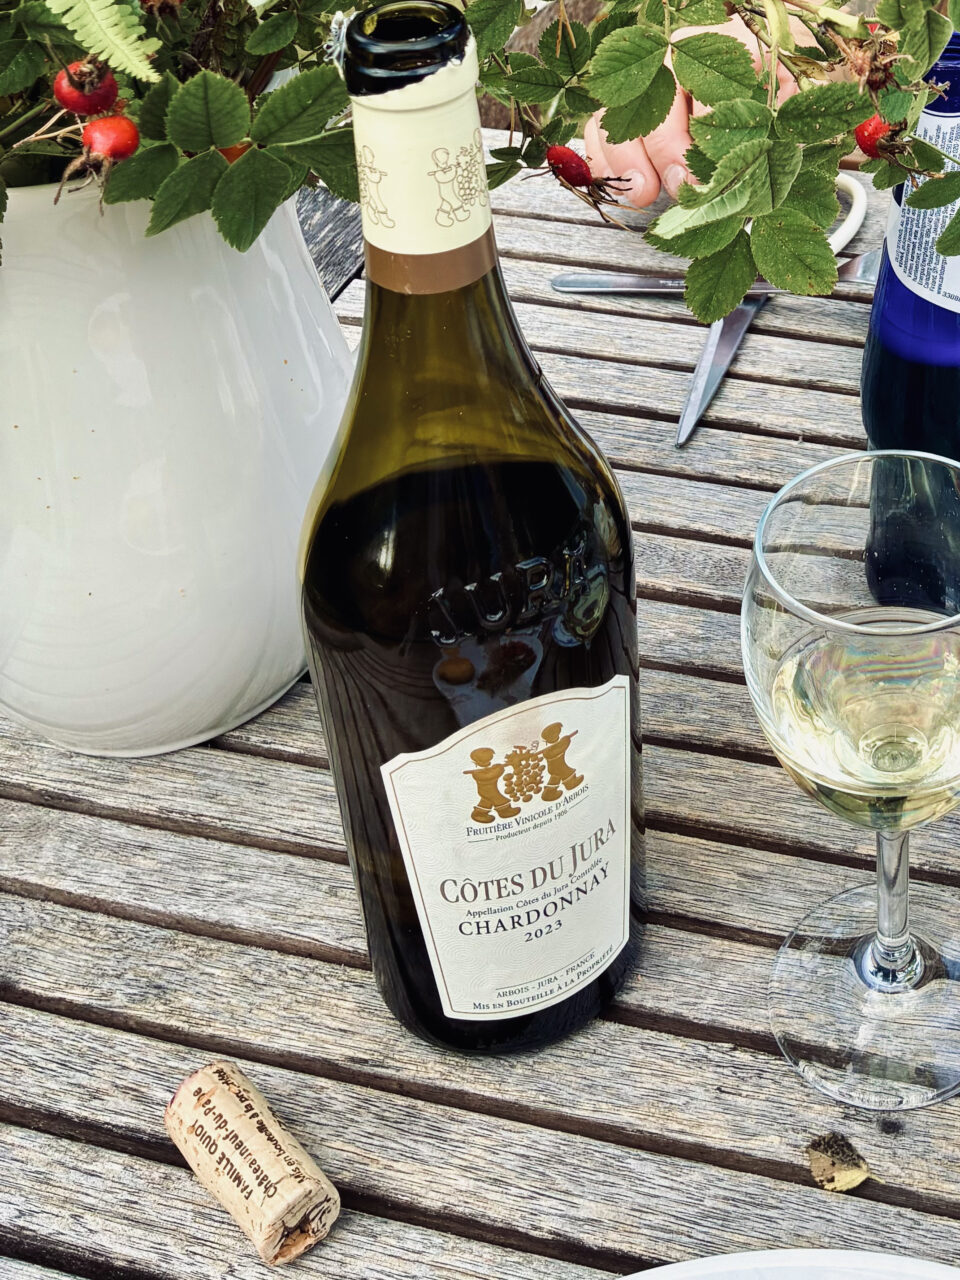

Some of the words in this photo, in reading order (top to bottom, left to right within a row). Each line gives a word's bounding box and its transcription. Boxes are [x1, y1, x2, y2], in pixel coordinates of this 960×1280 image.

[466, 819, 514, 837] FRUITIÈRE
[515, 806, 554, 827] VINICOLE
[555, 784, 589, 811] D'ARBOIS
[495, 827, 532, 841] Producteur
[532, 817, 553, 832] depuis
[554, 809, 568, 822] 1906
[440, 873, 524, 903] CÔTES
[529, 856, 564, 889] DU
[568, 818, 616, 878] JURA
[458, 861, 610, 936] CHARDONNAY
[466, 905, 514, 918] Appellation
[516, 896, 539, 908] Côtes
[541, 891, 552, 901] du
[553, 883, 569, 896] Jura
[570, 857, 603, 884] Contrôlée
[524, 919, 563, 942] 2023
[496, 986, 529, 998] ARBOIS
[537, 976, 558, 990] JURA
[565, 952, 595, 975] FRANCE
[507, 988, 555, 1007] BOUTEILLE
[564, 978, 575, 988] LA
[577, 944, 613, 980] PROPRIÉTÉ
[244, 1103, 255, 1113] la
[256, 1119, 287, 1158] bouteille
[284, 1156, 295, 1167] en
[216, 1151, 253, 1200] FAMILLE
[291, 1166, 306, 1184] Mis
